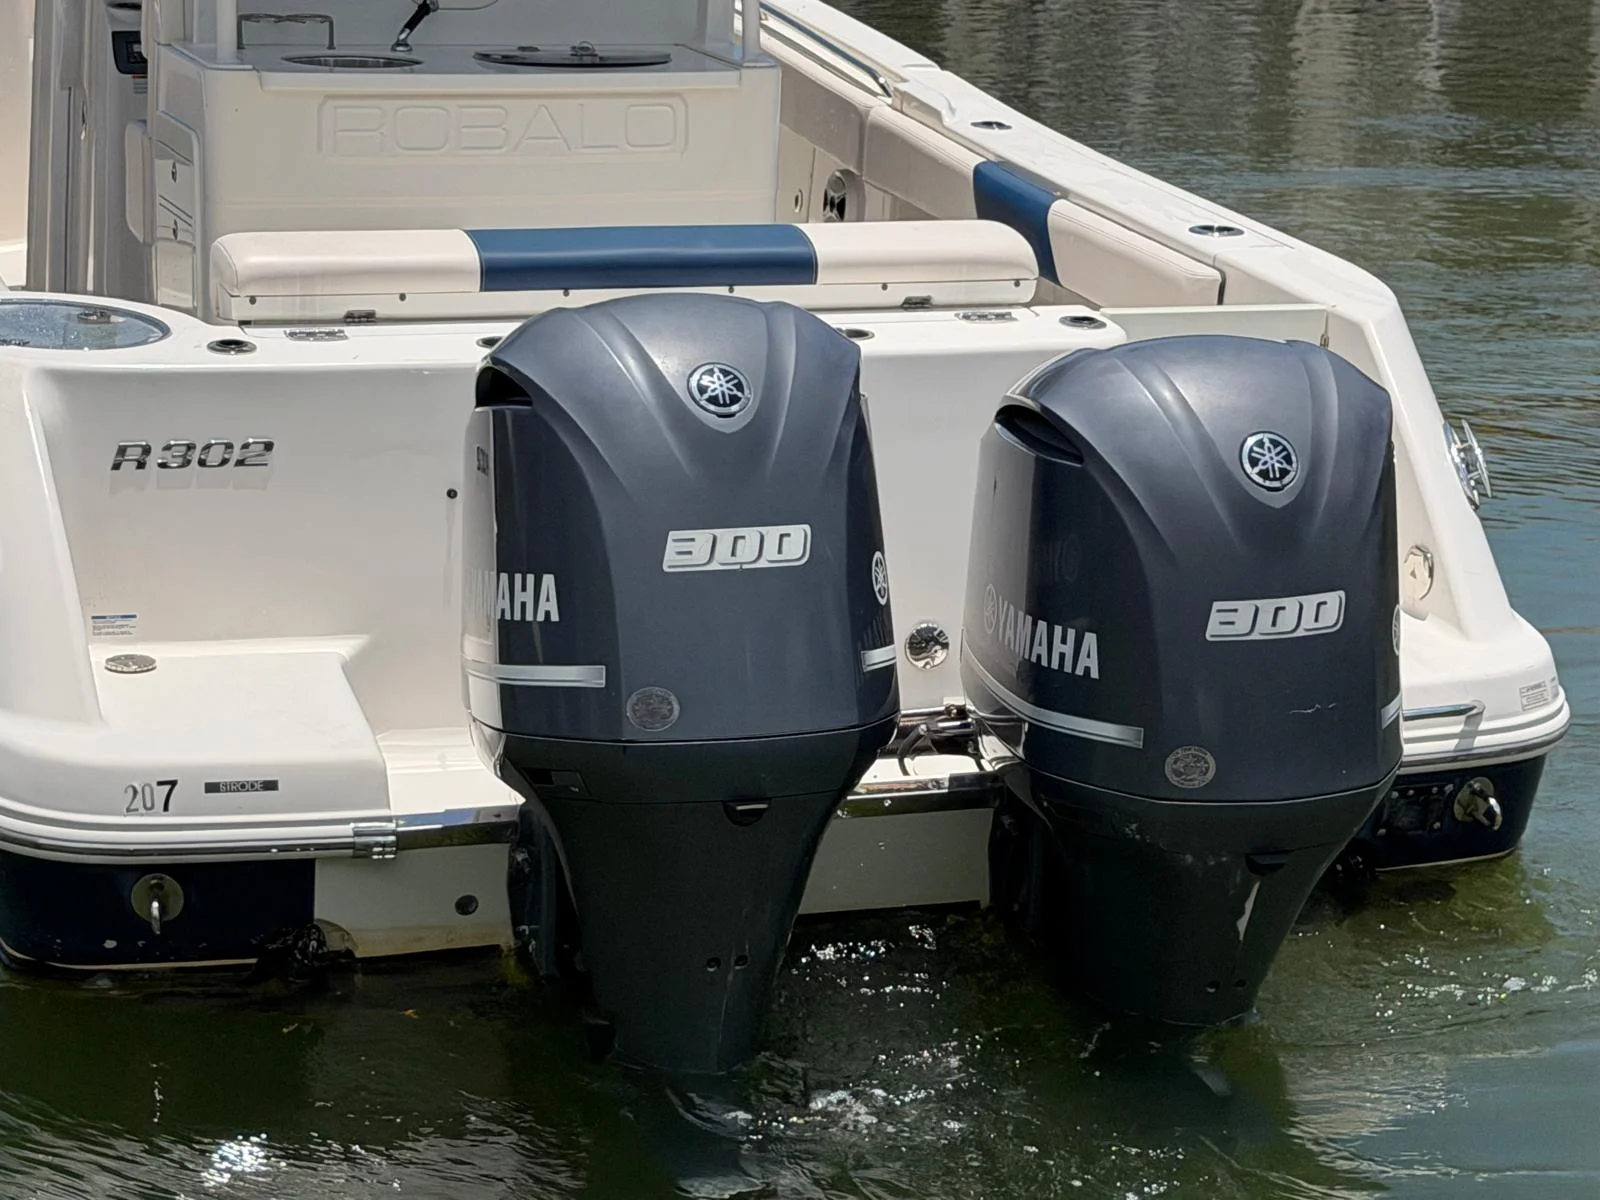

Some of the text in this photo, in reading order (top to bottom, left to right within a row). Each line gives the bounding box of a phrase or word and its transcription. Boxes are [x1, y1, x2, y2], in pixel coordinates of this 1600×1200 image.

[333, 103, 676, 152] ROBALO
[110, 438, 275, 471] R302
[663, 524, 811, 572] 300
[998, 595, 1099, 680] YAMAHA
[1206, 590, 1346, 641] 300
[124, 779, 178, 813] 207
[219, 780, 264, 792] STRODE
